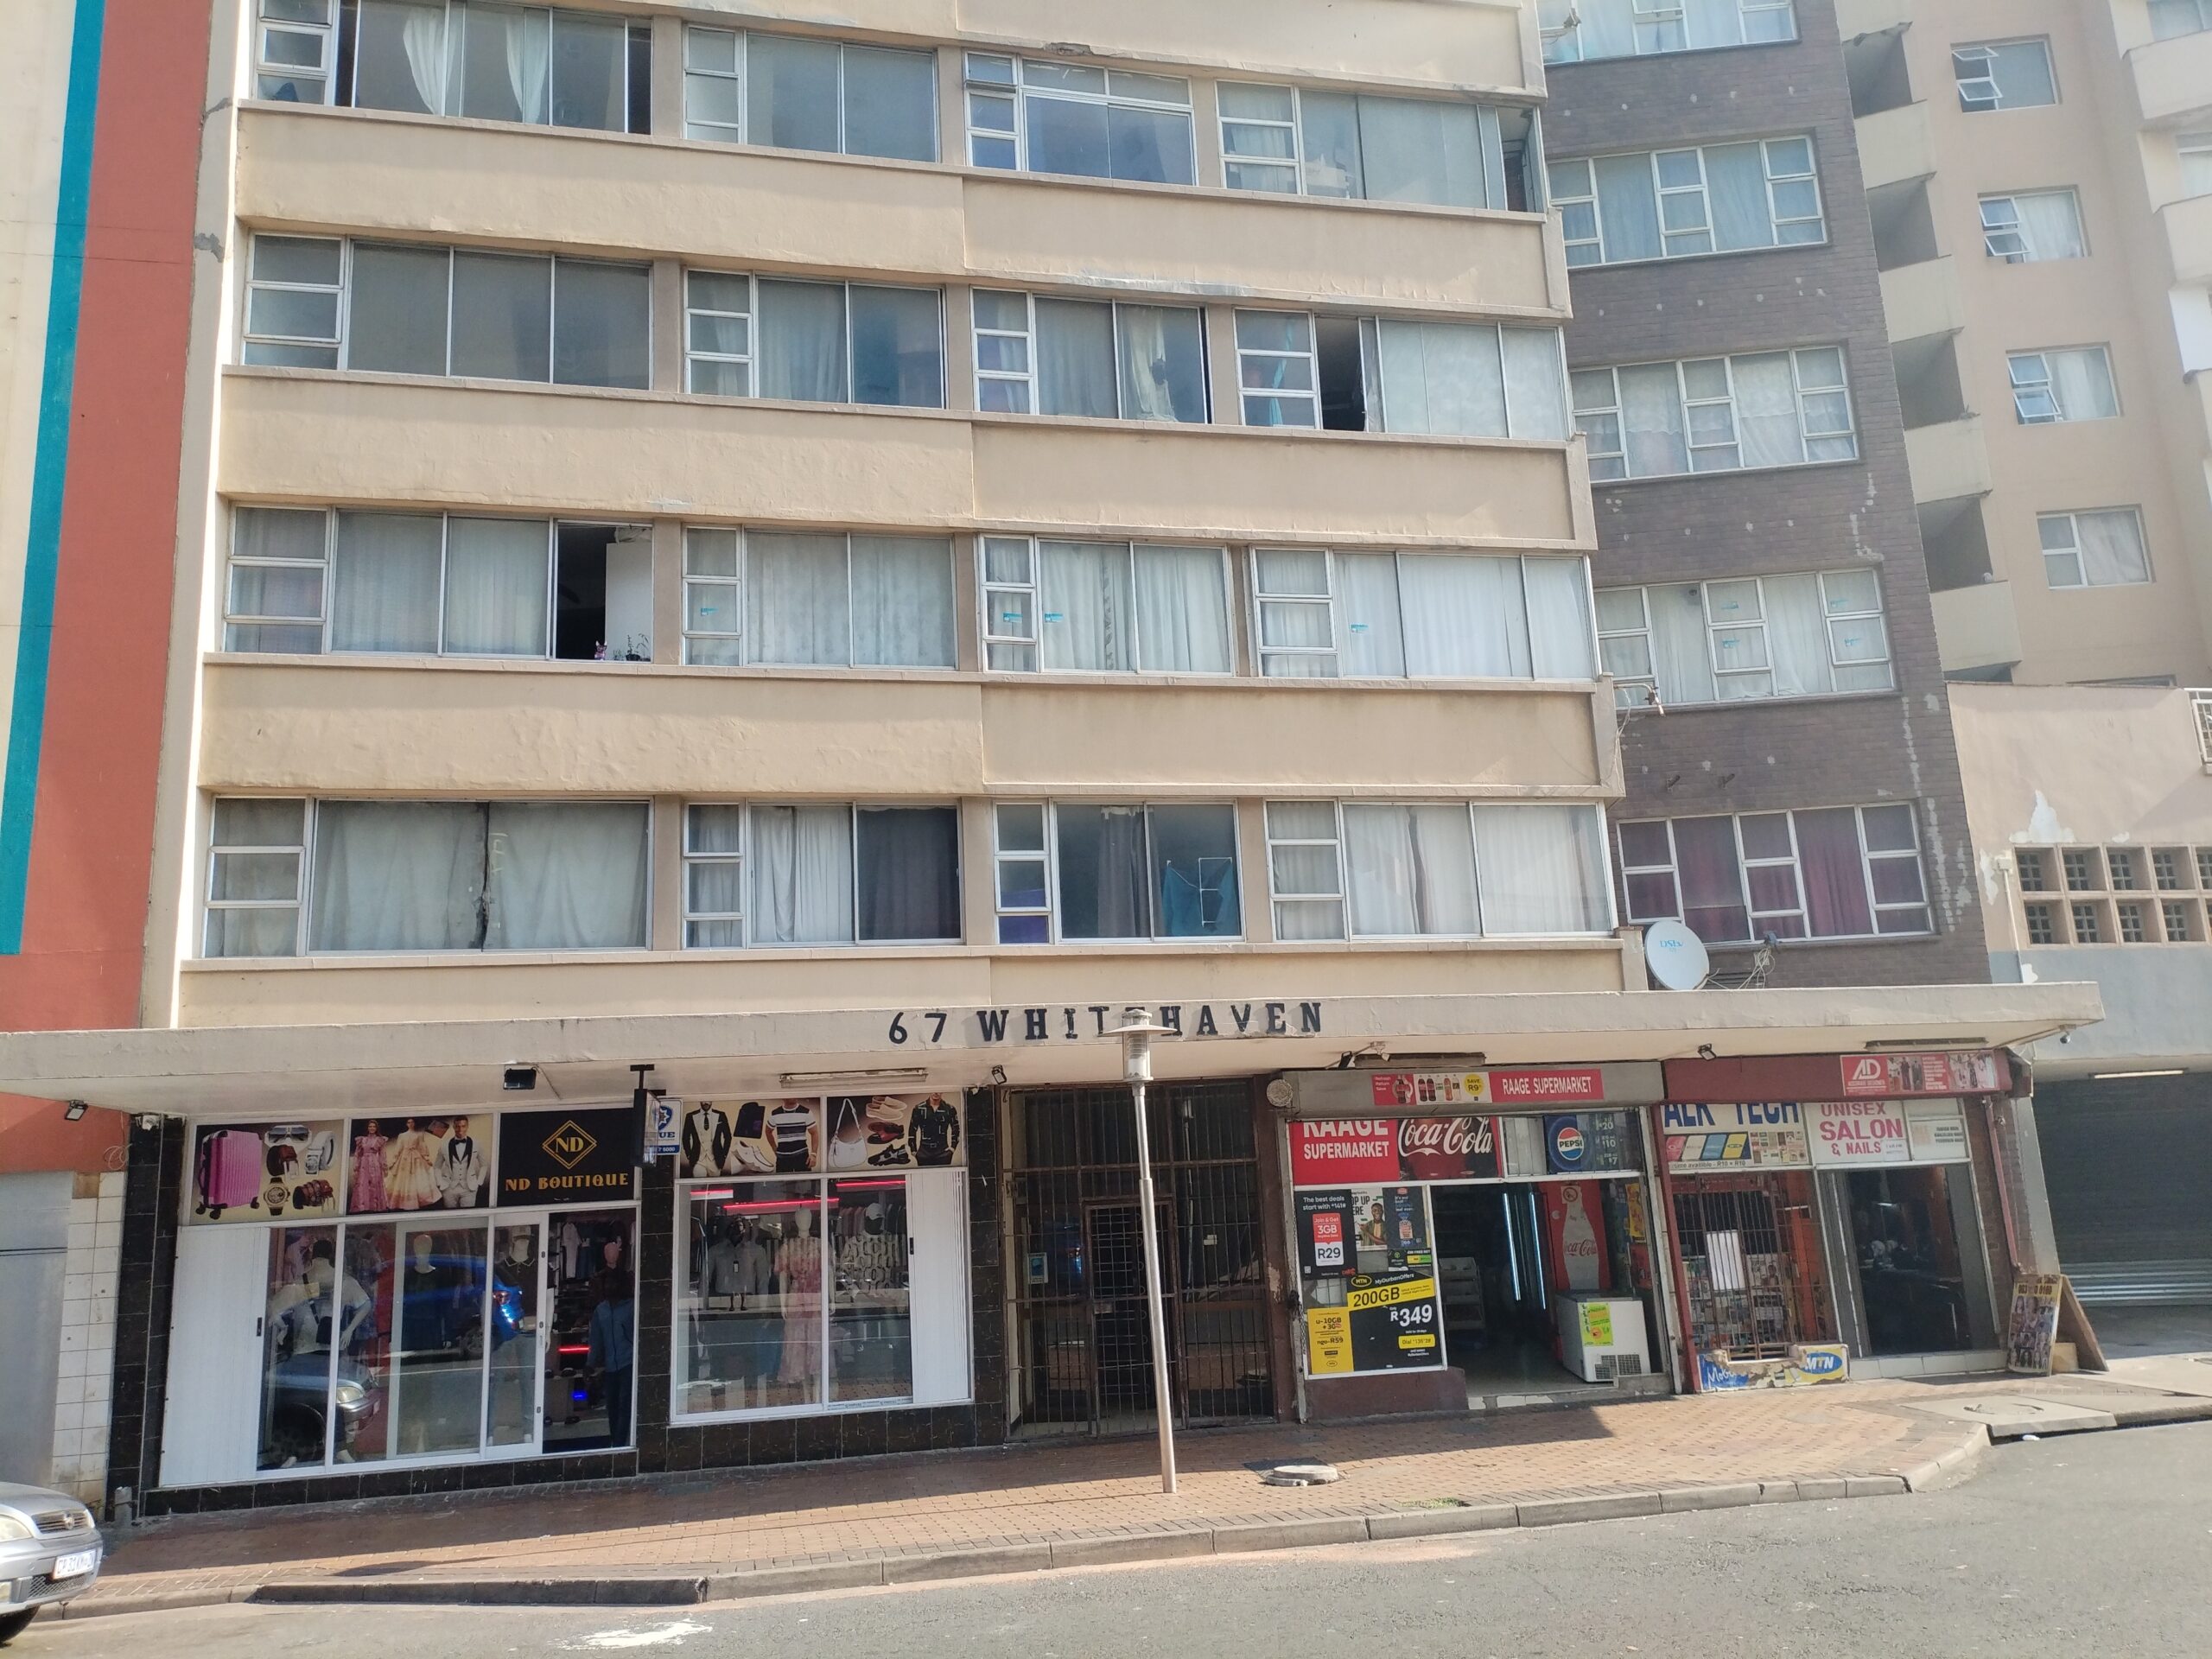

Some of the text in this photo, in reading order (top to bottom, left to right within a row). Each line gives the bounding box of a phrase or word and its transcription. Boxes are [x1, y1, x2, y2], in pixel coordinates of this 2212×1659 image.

[889, 1002, 1321, 1044] 67 WHITHAVEN
[1503, 1077, 1592, 1095] RAAGE SUPERMARKET
[1821, 1103, 1887, 1116] UNISEX
[1398, 1117, 1493, 1157] Coca-Cola
[1819, 1118, 1904, 1141] SALON
[556, 1137, 584, 1153] ND
[1304, 1141, 1389, 1160] SUPERMARKET
[1831, 1143, 1840, 1156] &
[1846, 1141, 1881, 1155] NAILS
[505, 1173, 629, 1192] ND BOUTIQUE
[1361, 1195, 1370, 1205] UP
[1317, 1224, 1338, 1234] 3GB
[1318, 1247, 1341, 1259] R29
[1375, 1274, 1414, 1285] MyDurbanOffers
[1353, 1287, 1400, 1307] 200GB
[1805, 1357, 1834, 1370] MTN
